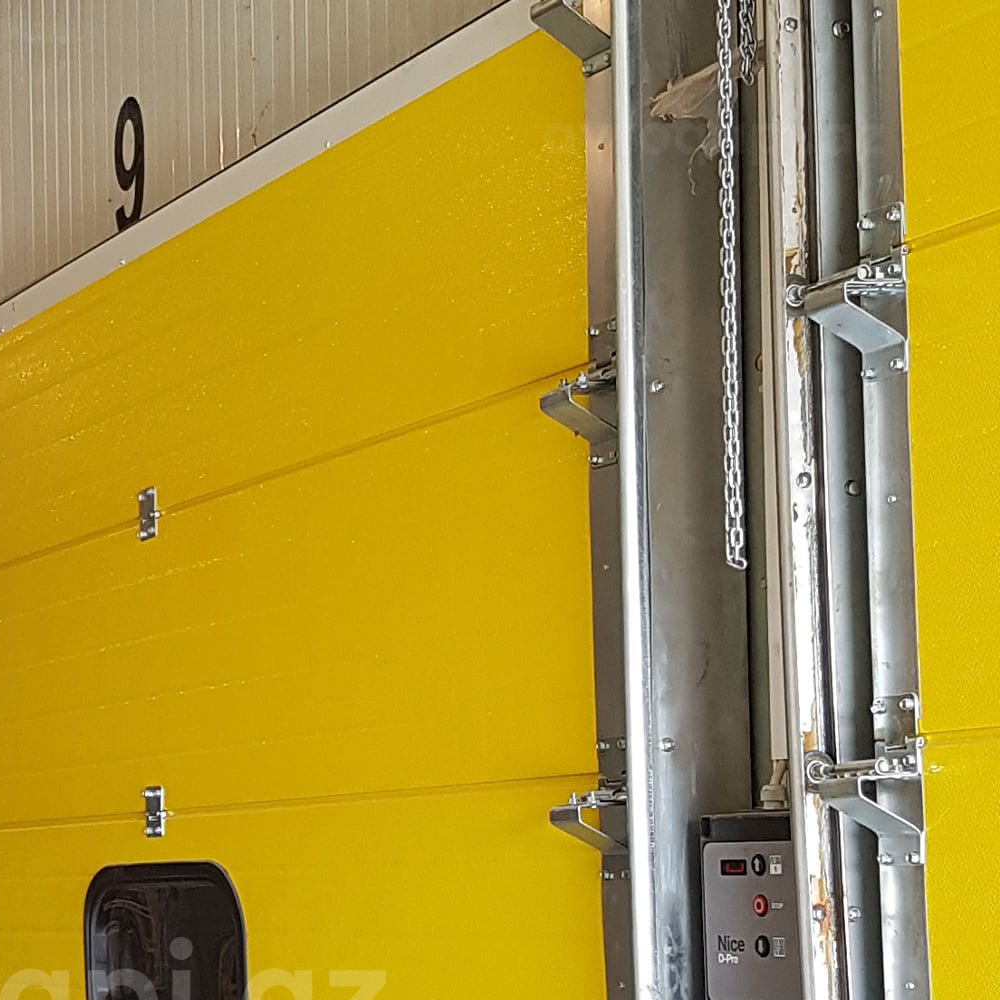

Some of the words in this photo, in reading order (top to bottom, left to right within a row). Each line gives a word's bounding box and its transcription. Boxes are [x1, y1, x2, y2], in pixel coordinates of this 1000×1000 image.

[114, 96, 145, 232] 9
[717, 935, 746, 953] Nice
[718, 953, 740, 965] D-Pro
